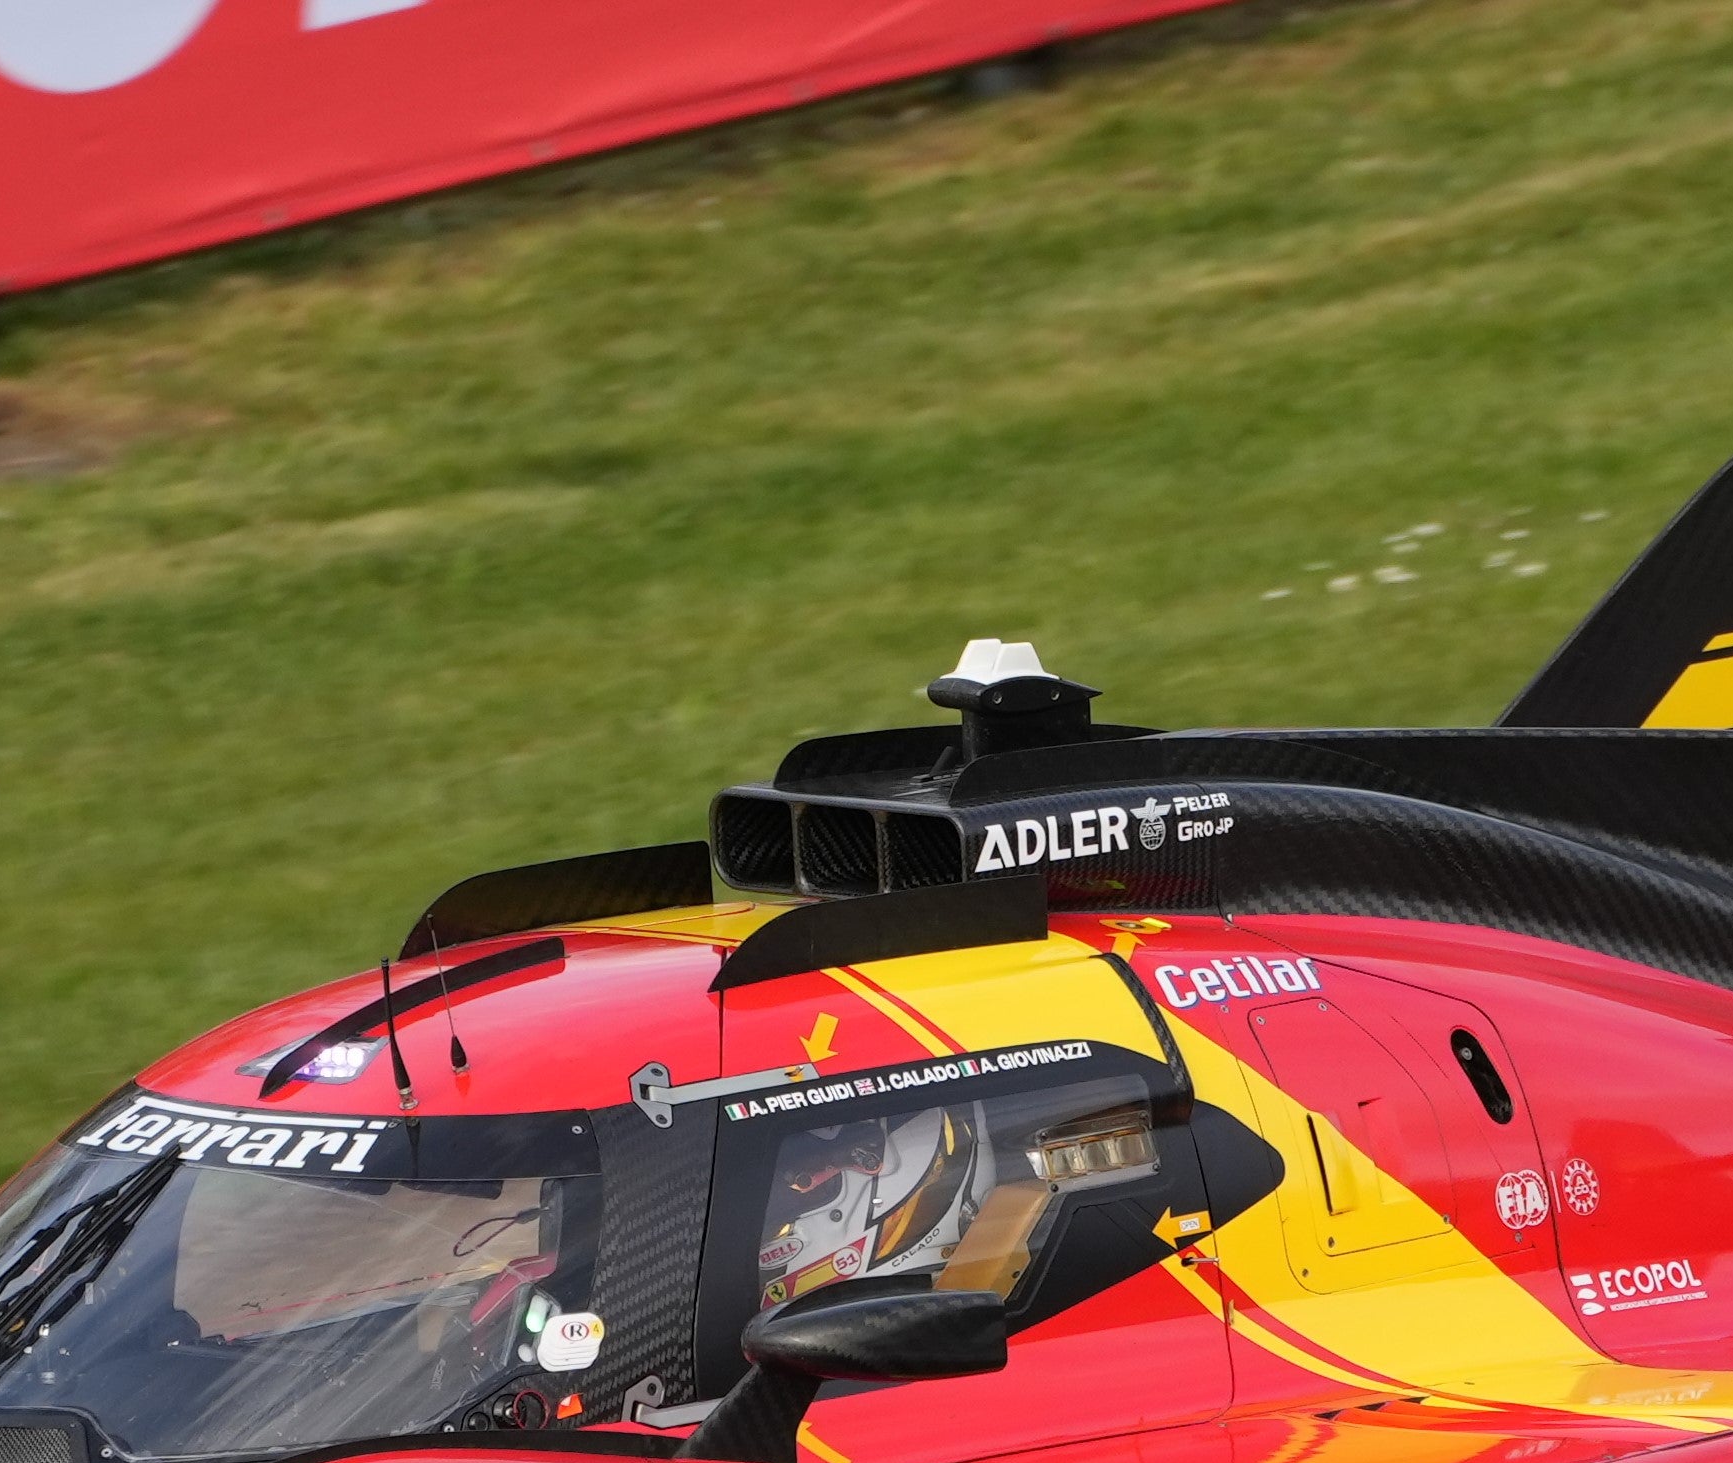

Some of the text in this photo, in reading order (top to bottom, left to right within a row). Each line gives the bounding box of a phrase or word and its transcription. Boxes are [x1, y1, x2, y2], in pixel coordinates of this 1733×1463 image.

[974, 792, 1231, 873] ADLER PELZER
[1155, 954, 1322, 1009] Cetilar
[807, 1083, 855, 1105] GUIDI
[78, 1096, 391, 1174] Ferrari
[835, 1251, 861, 1270] 51
[892, 1227, 940, 1268] CALADO
[1598, 1259, 1702, 1299] ECOPOL
